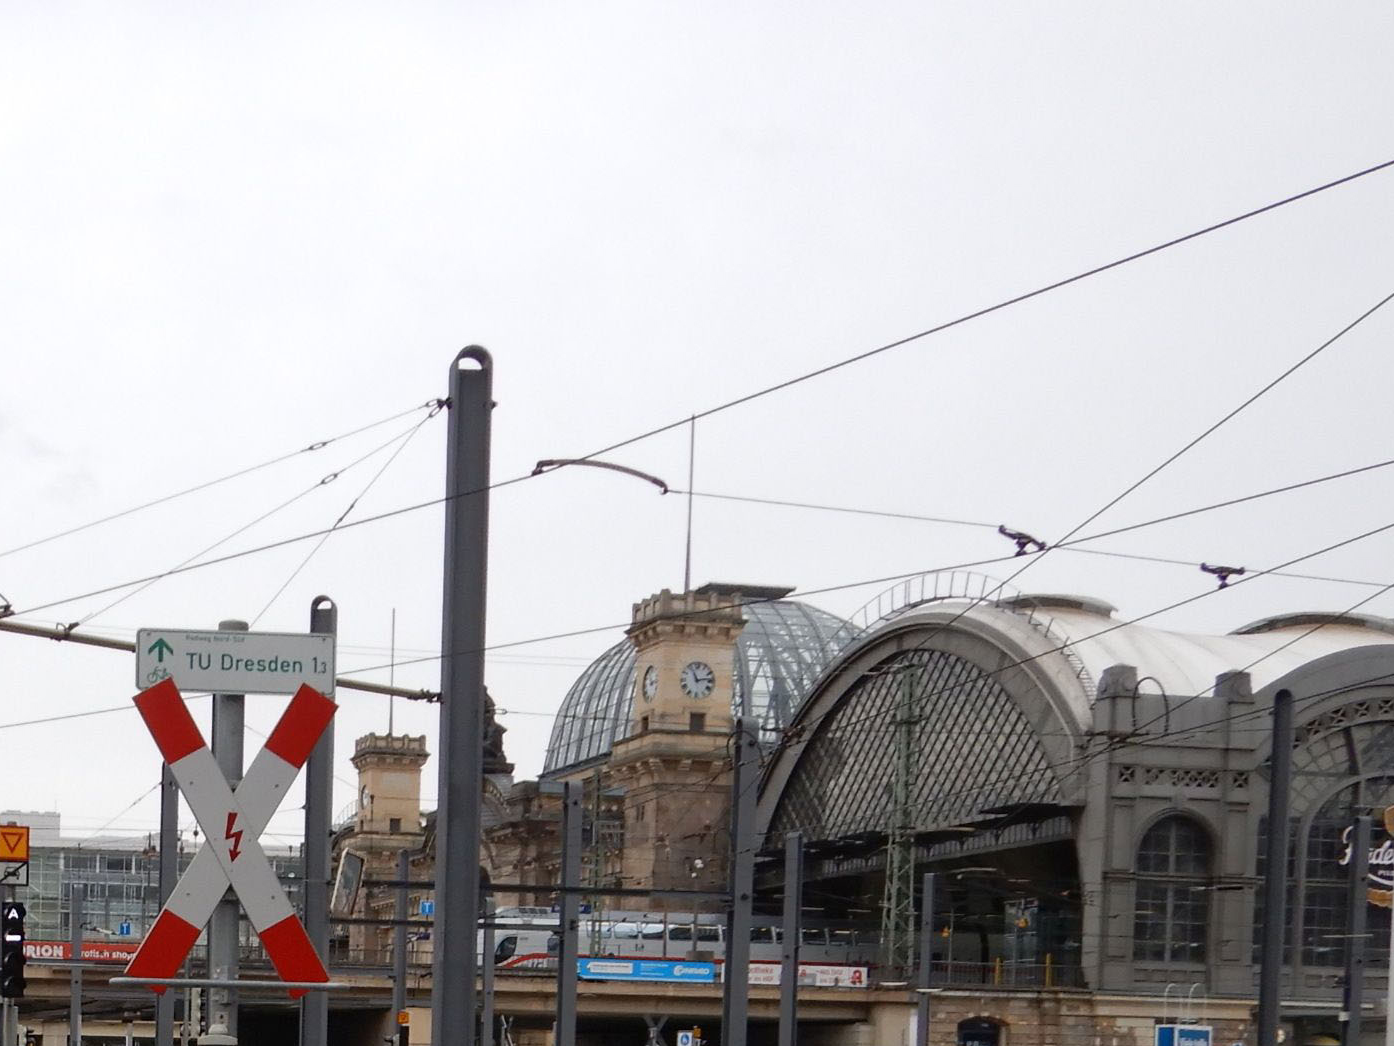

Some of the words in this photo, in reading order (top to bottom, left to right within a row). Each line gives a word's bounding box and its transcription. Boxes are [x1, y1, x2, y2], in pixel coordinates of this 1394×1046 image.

[186, 653, 211, 670] TU
[221, 654, 303, 673] Dresden
[8, 908, 19, 919] A
